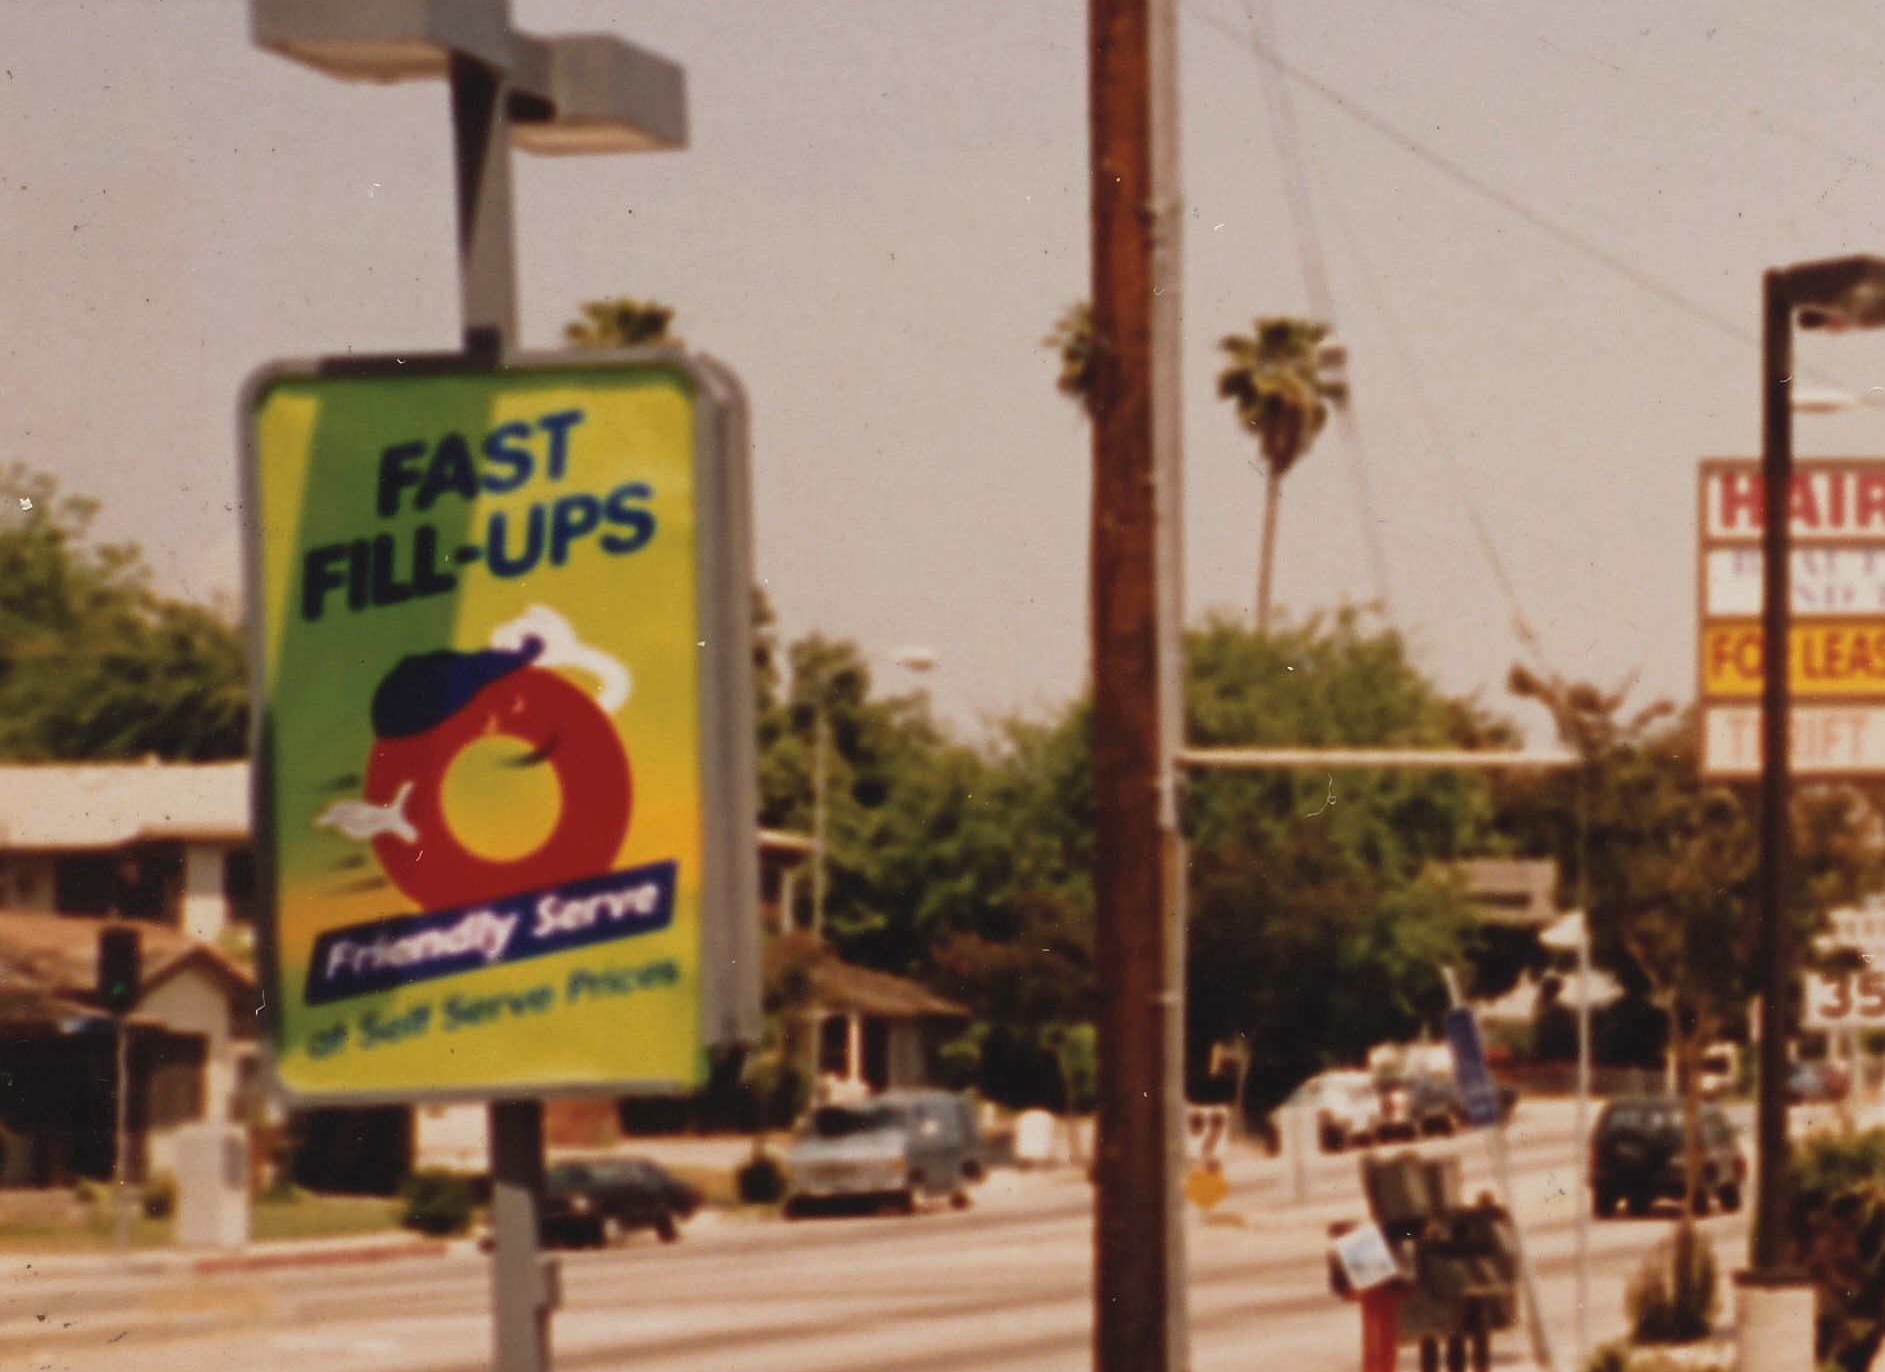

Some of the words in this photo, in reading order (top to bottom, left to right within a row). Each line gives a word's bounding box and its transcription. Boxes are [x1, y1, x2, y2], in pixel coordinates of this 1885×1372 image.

[376, 408, 586, 520] FAST
[302, 483, 657, 624] FILL-UPS
[1710, 632, 1768, 680] FO
[325, 907, 522, 981] Friendly
[531, 881, 660, 938] Serve
[440, 983, 556, 1034] Serve
